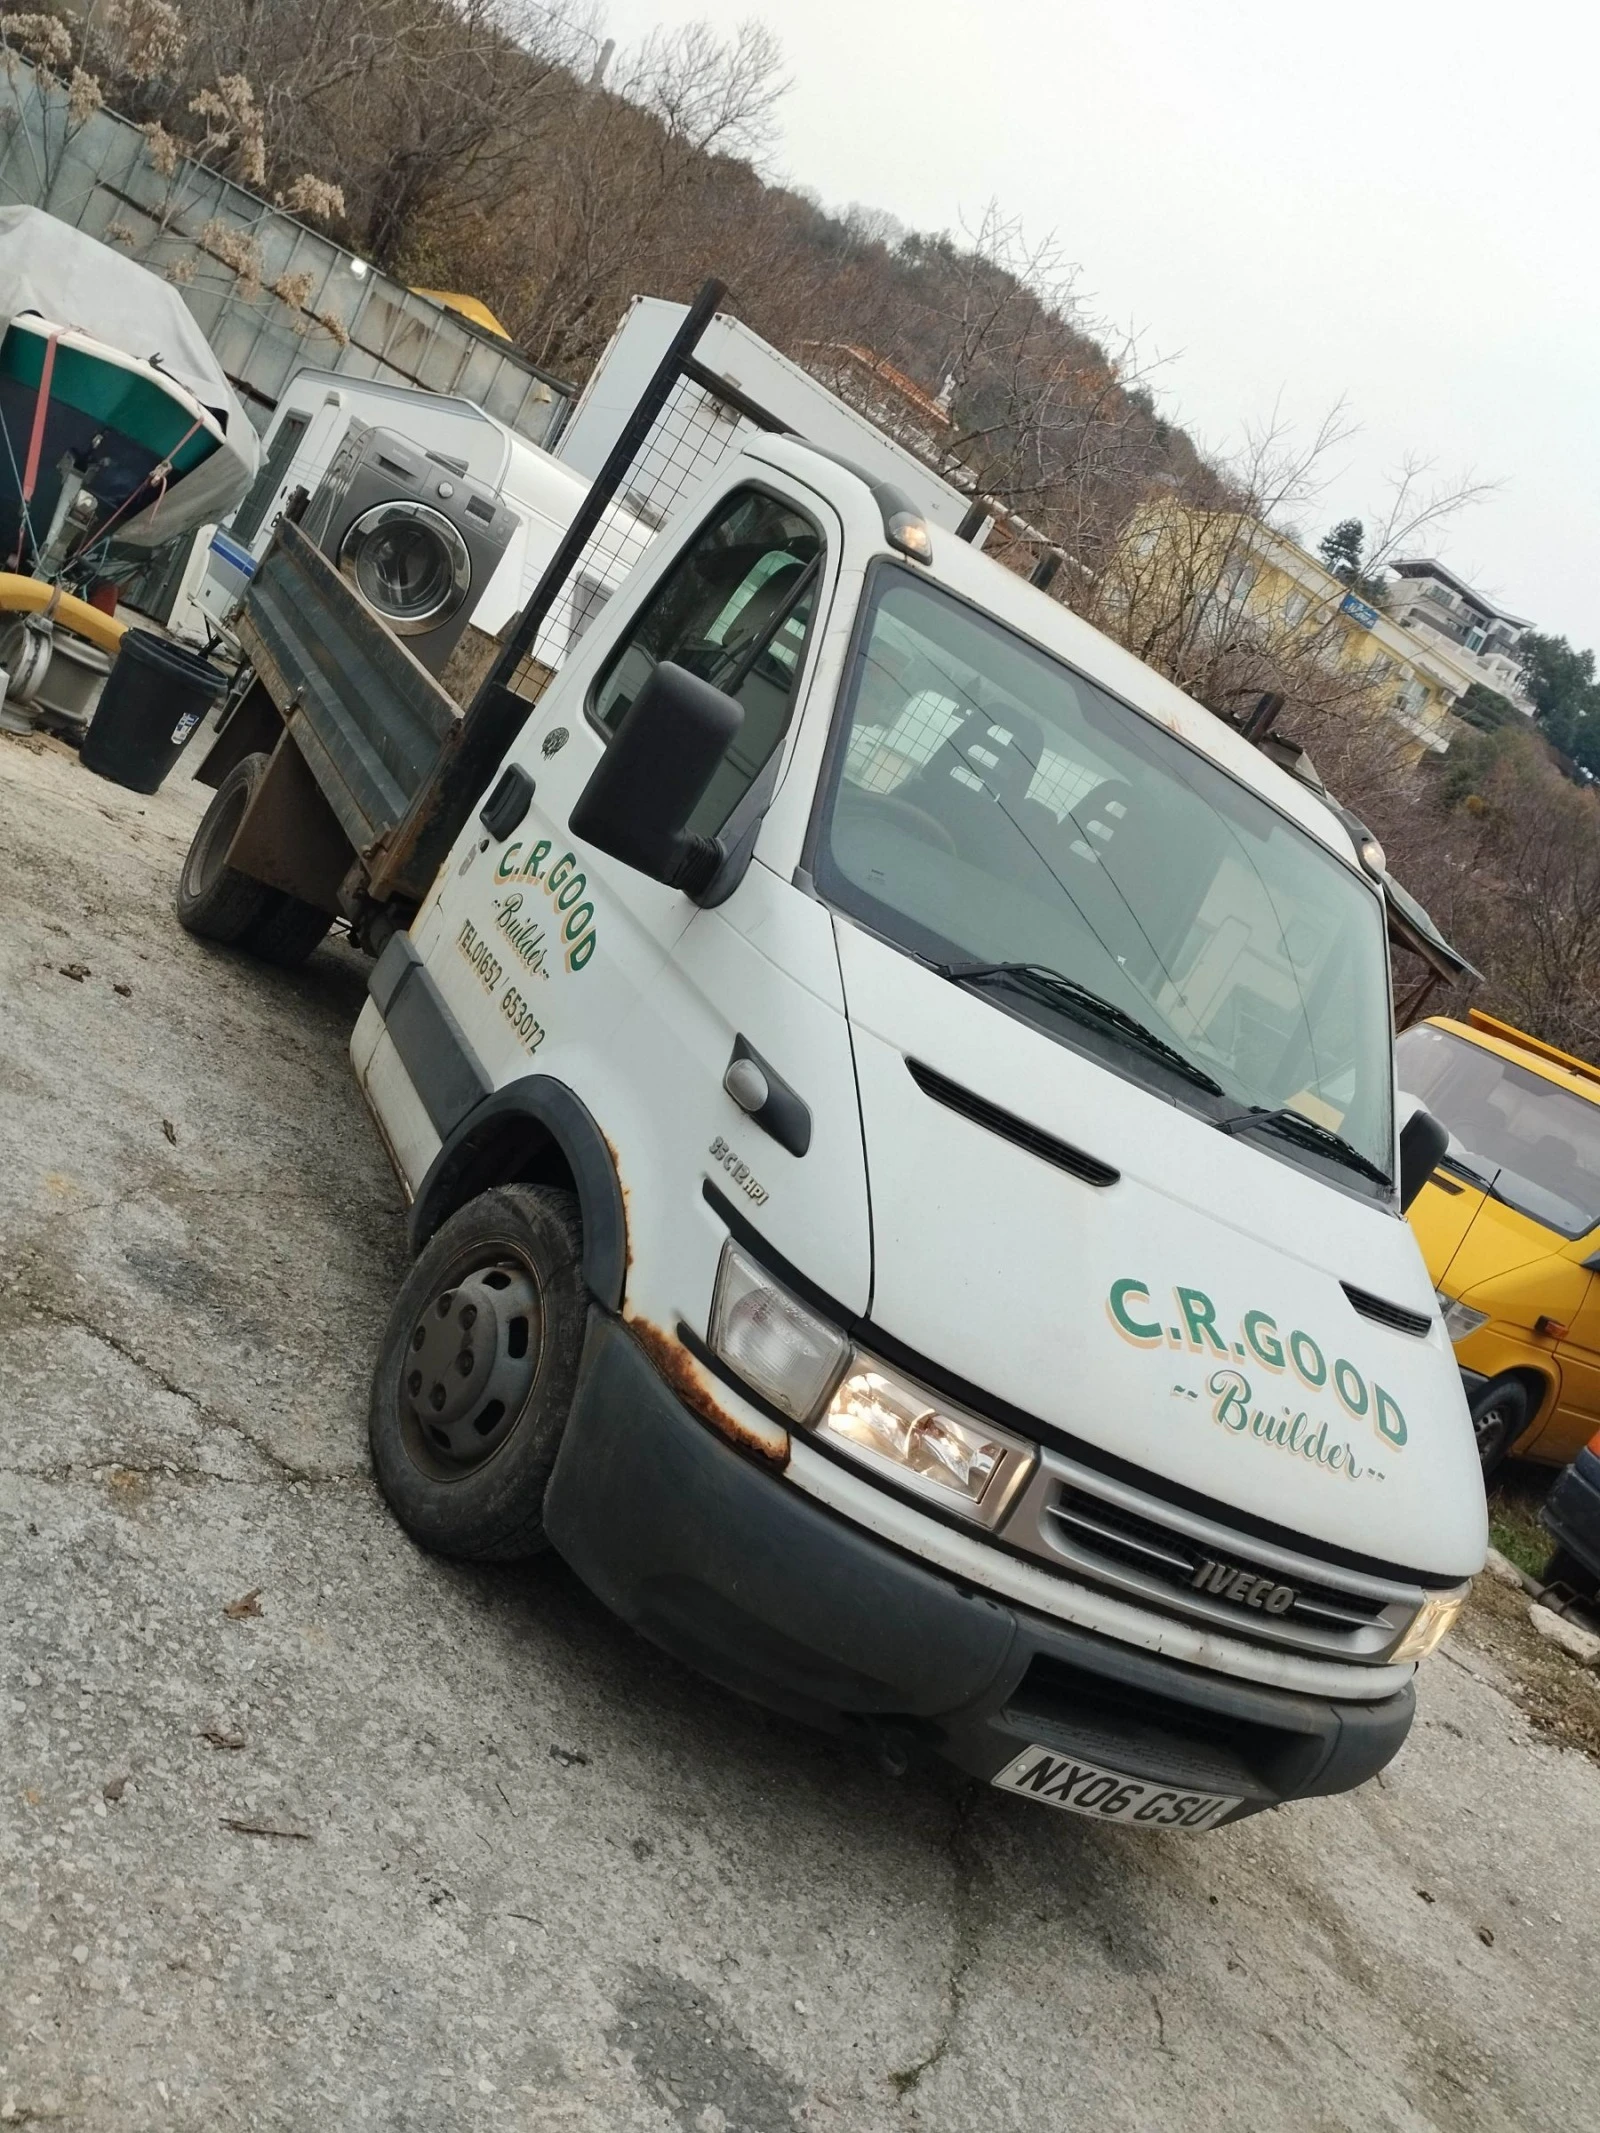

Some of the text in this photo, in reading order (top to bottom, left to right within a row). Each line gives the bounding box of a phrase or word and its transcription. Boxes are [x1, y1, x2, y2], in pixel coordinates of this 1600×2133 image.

[501, 986, 546, 1056] 653072
[1193, 1558, 1296, 1614] IVECO
[1015, 1756, 1224, 1828] NX06 GSU
